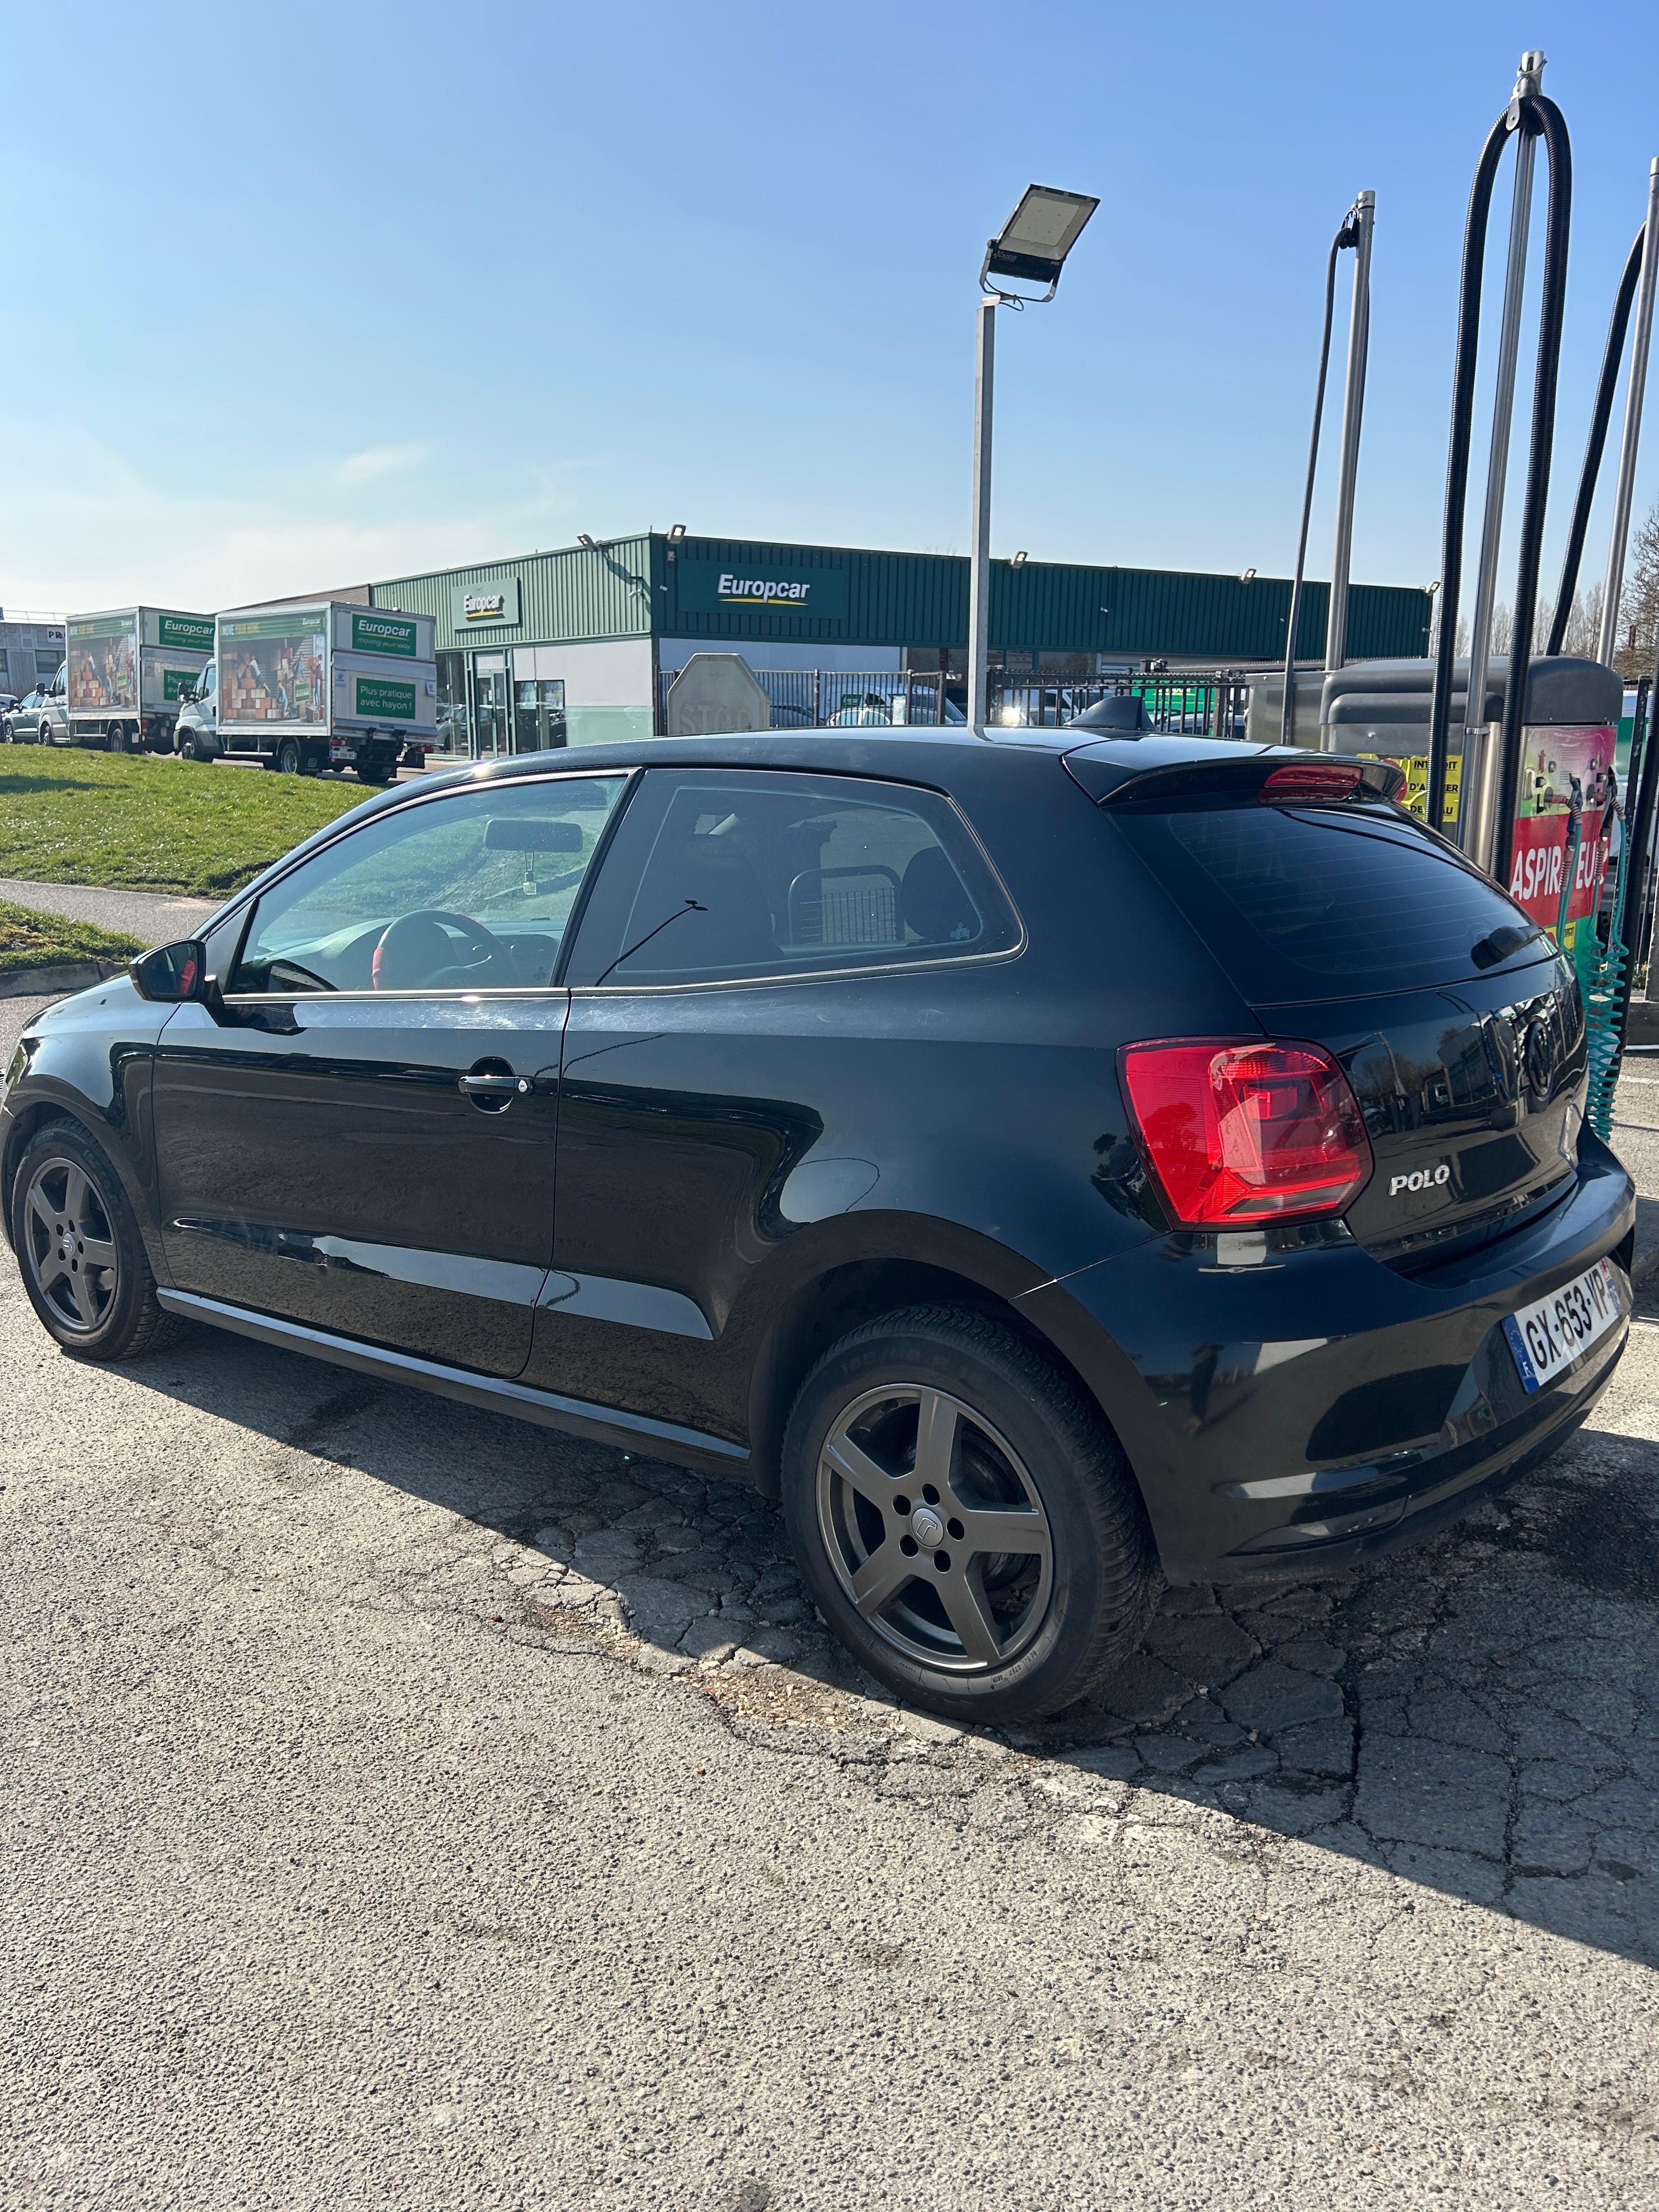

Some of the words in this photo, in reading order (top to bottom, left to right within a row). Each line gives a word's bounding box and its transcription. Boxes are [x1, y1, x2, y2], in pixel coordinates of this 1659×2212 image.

[718, 574, 810, 603] Europcar
[464, 594, 501, 614] Europcar
[165, 620, 214, 635] Europcar
[358, 619, 411, 637] Europcar
[358, 637, 381, 646] moving
[360, 686, 377, 695] Plus
[379, 689, 412, 699] pratique
[360, 699, 380, 707] avec
[382, 699, 407, 710] hayon
[1389, 1165, 1450, 1196] POLO
[1526, 1268, 1609, 1370] GX-653-VP
